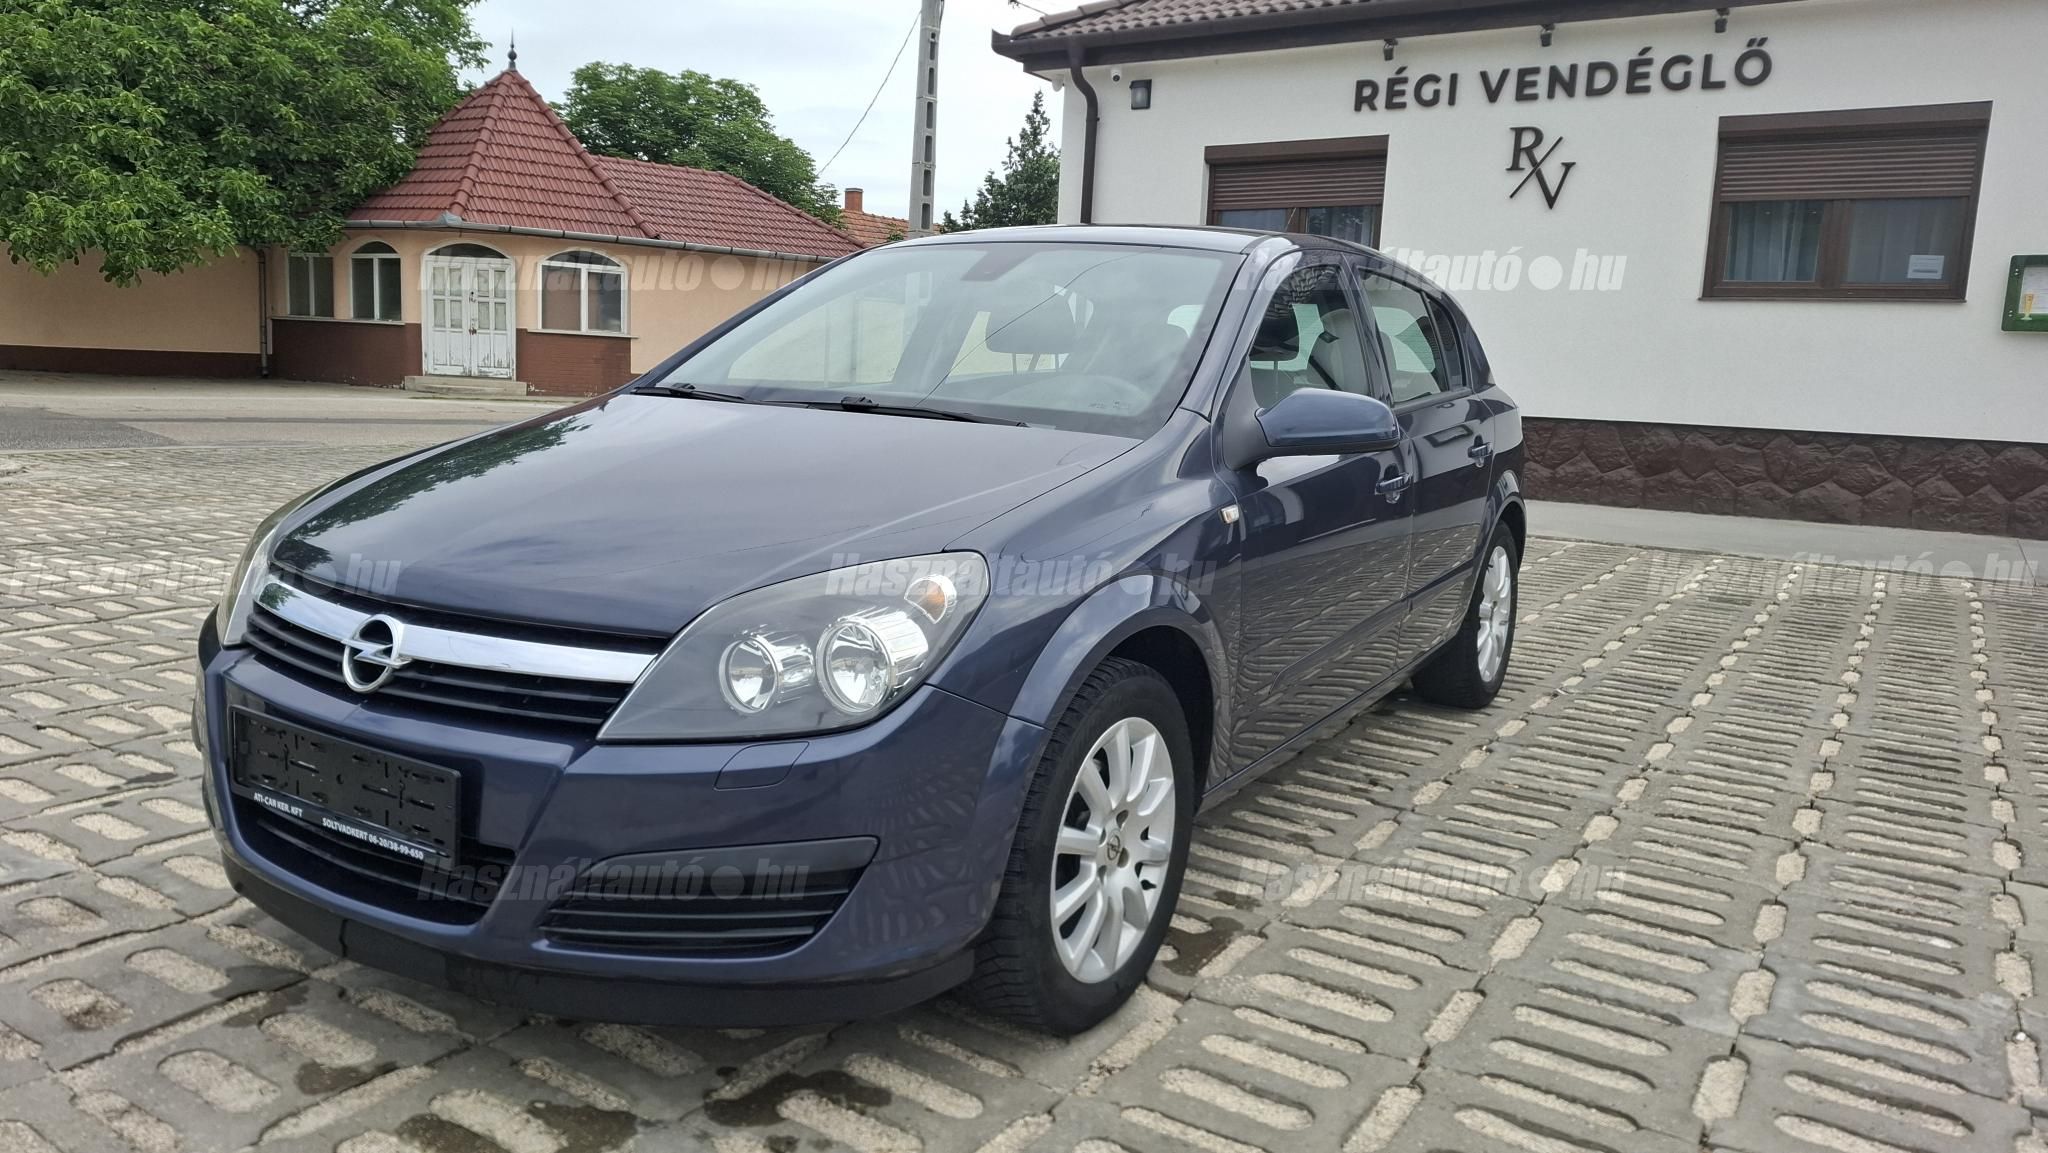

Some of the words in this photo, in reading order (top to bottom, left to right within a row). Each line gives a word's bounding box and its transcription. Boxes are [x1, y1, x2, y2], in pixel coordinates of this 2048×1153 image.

[1353, 66, 1459, 112] RÉGI
[1480, 36, 1774, 103] VENDÉGLŐ
[291, 805, 304, 818] KFT
